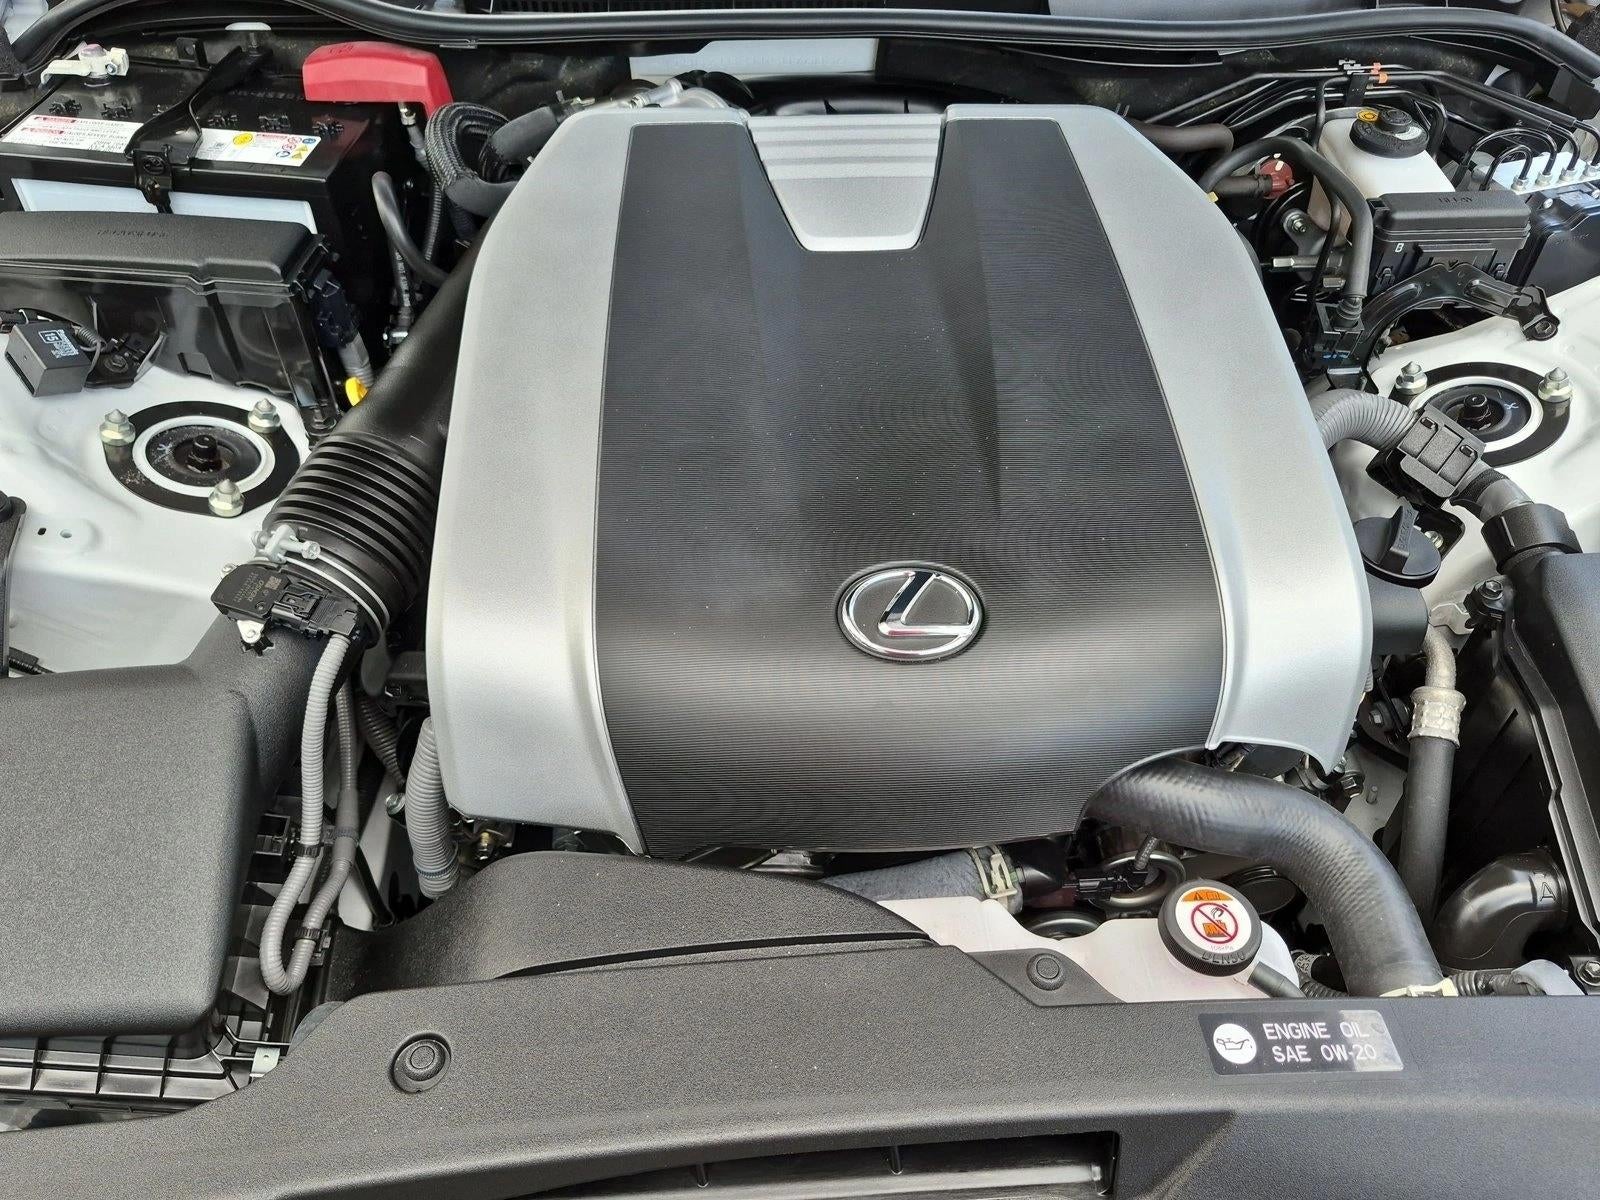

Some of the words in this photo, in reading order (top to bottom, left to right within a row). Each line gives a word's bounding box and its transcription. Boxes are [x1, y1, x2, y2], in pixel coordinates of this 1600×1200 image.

[1395, 243, 1404, 252] B
[1201, 950, 1248, 965] DENSO
[1262, 1021, 1331, 1041] ENGINE
[1339, 1021, 1370, 1039] OIL
[1271, 1045, 1312, 1064] SAE
